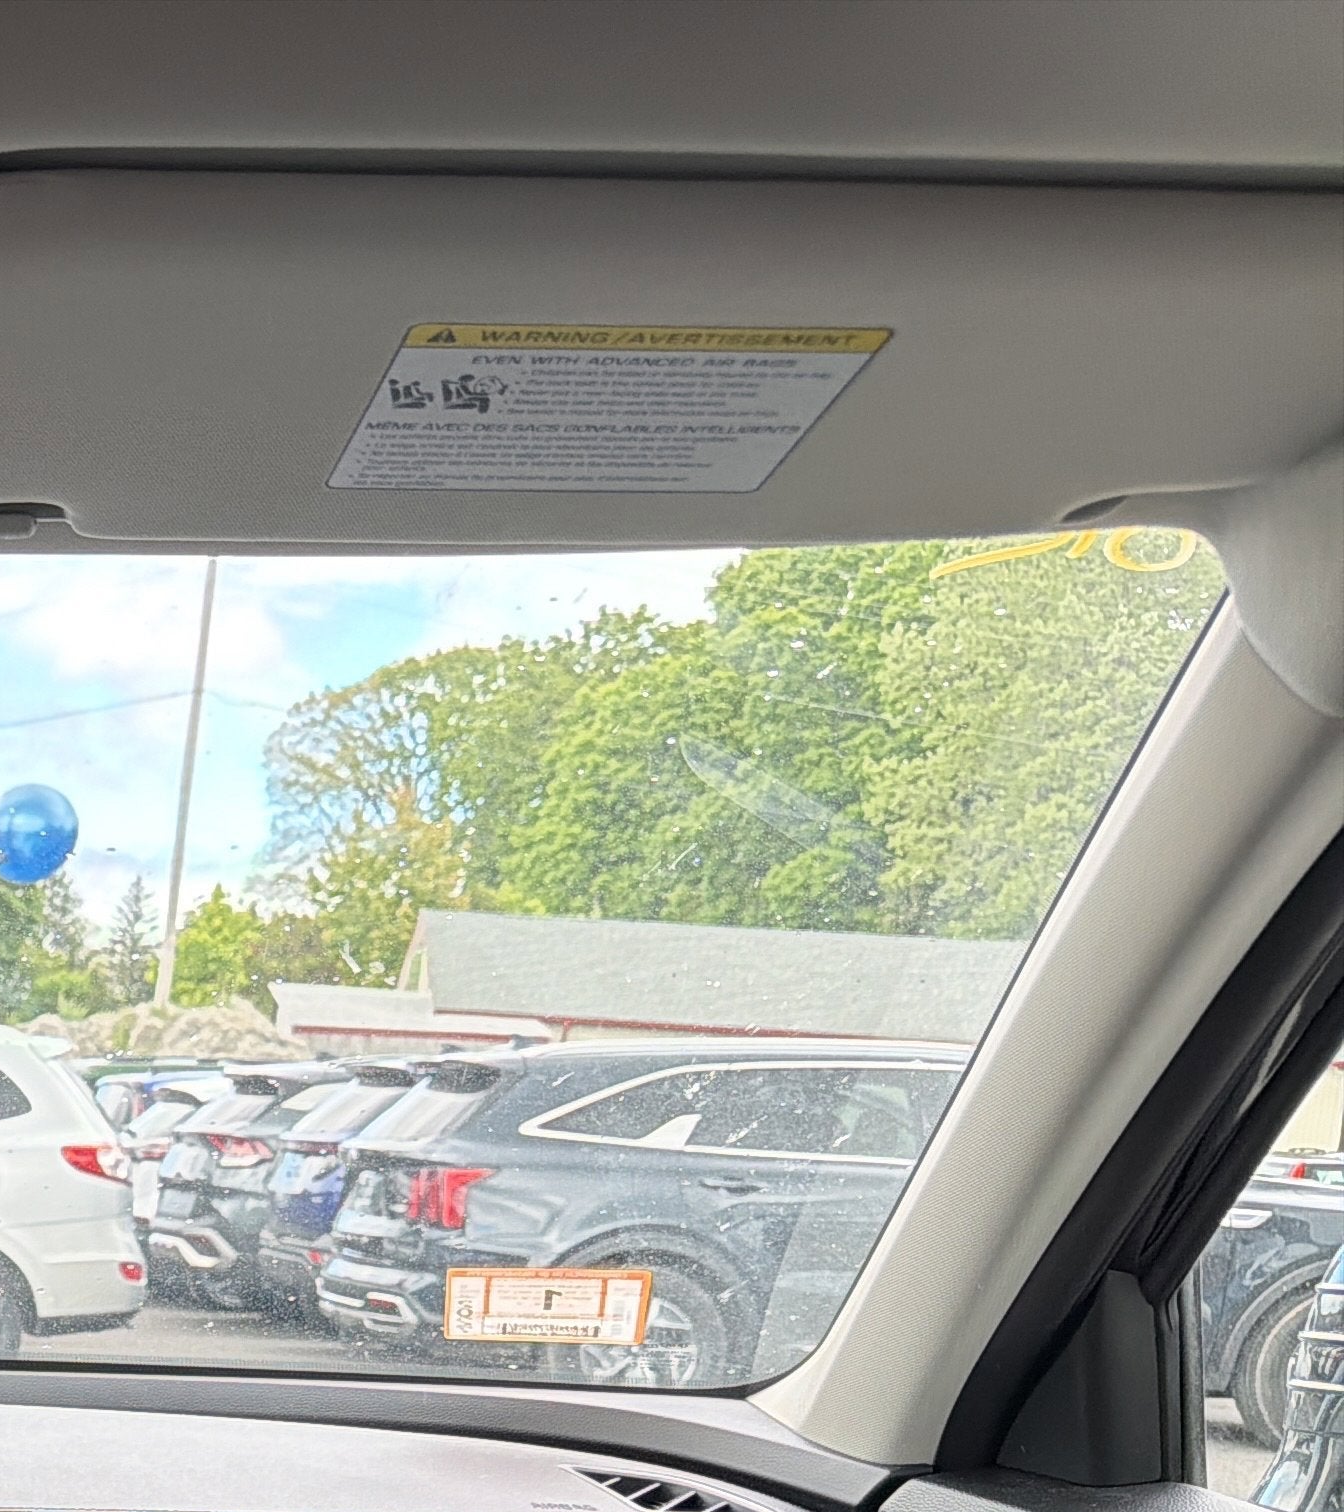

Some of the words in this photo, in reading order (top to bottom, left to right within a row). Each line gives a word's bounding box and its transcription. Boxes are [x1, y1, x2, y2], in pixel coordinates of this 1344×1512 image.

[480, 330, 609, 344] WARNING
[472, 355, 522, 365] EVEN
[531, 356, 579, 366] WITH
[588, 356, 695, 367] ADVANCED
